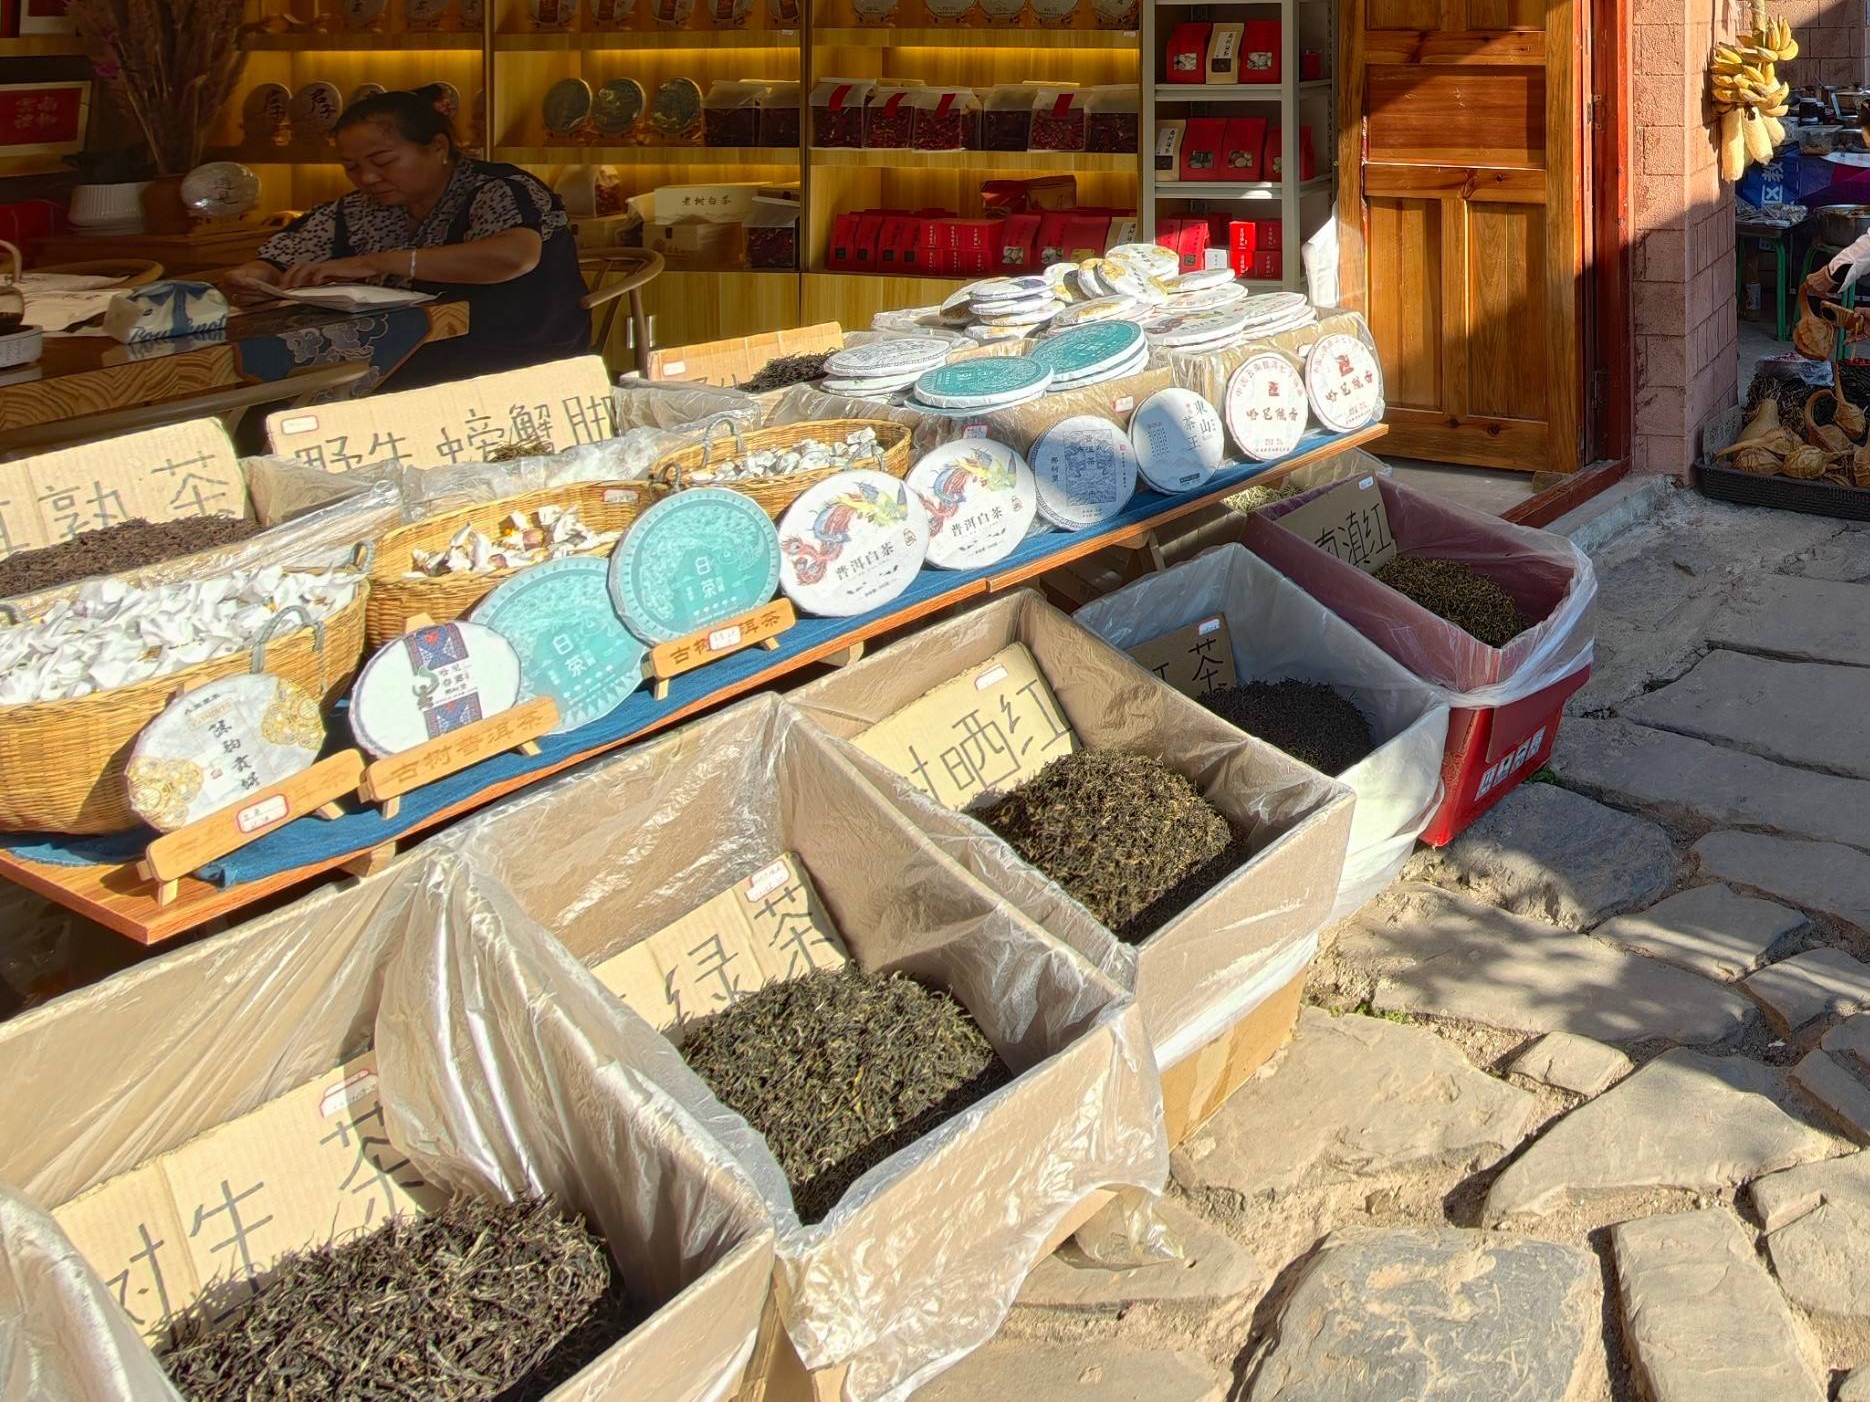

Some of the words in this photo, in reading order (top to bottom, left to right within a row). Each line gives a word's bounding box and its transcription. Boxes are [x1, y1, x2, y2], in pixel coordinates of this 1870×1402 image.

[951, 506, 1004, 538] 普洱白茶
[834, 541, 895, 582] 普洱白茶
[391, 710, 543, 783] 古树普洱茶
